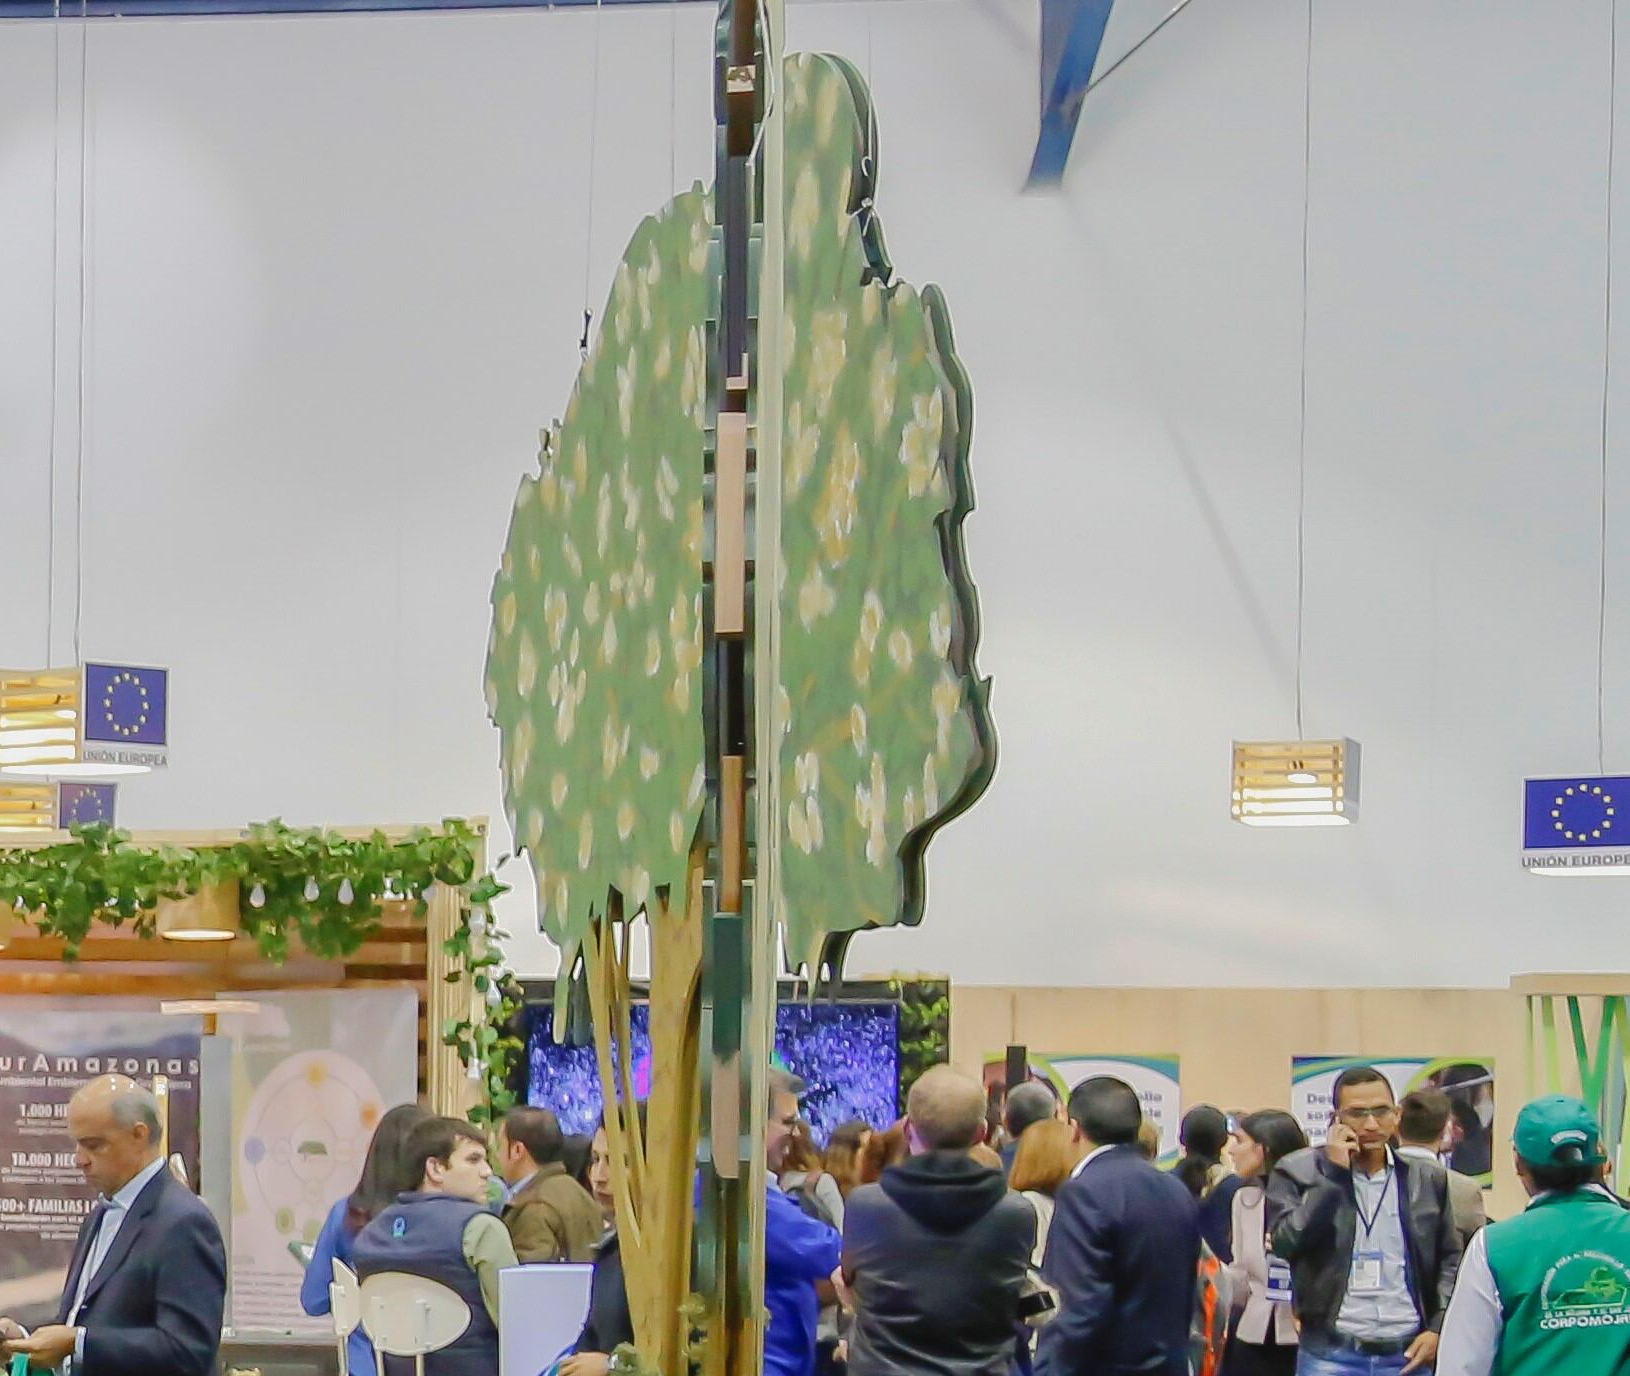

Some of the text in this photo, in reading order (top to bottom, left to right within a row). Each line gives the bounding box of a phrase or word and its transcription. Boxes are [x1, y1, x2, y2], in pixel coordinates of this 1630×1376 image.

[1522, 854, 1630, 867] UNIÓN EUROPE
[20, 1103, 52, 1118] 1.000
[28, 1198, 84, 1214] FAMILIAS
[1540, 1313, 1630, 1330] CORPOMOJA
